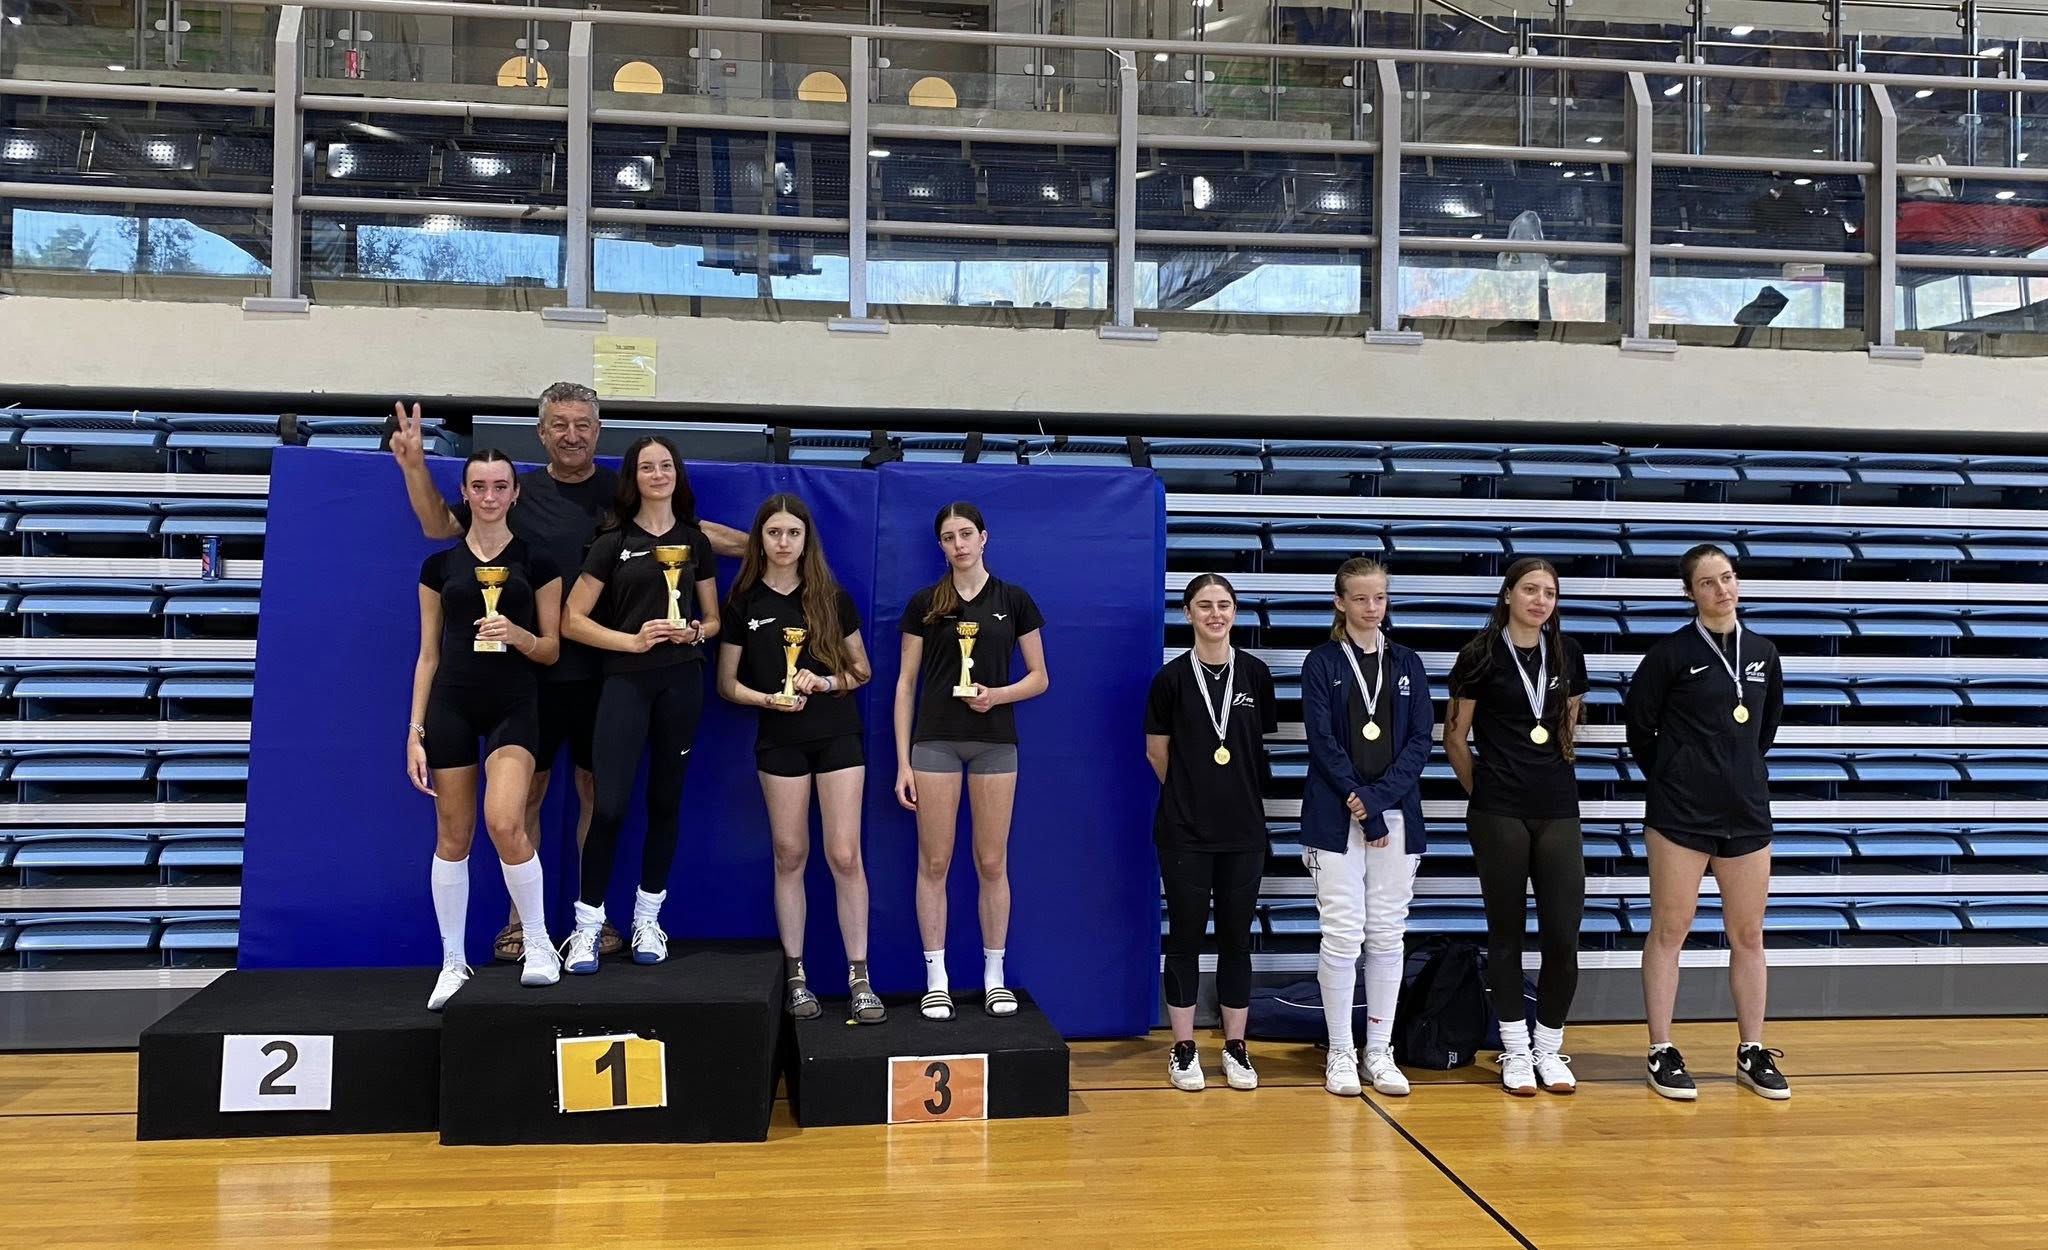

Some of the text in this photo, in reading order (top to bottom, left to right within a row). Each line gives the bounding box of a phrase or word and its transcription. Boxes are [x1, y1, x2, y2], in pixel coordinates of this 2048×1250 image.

[259, 1040, 298, 1095] 2
[595, 1041, 628, 1106] 1
[924, 1061, 952, 1115] 3
